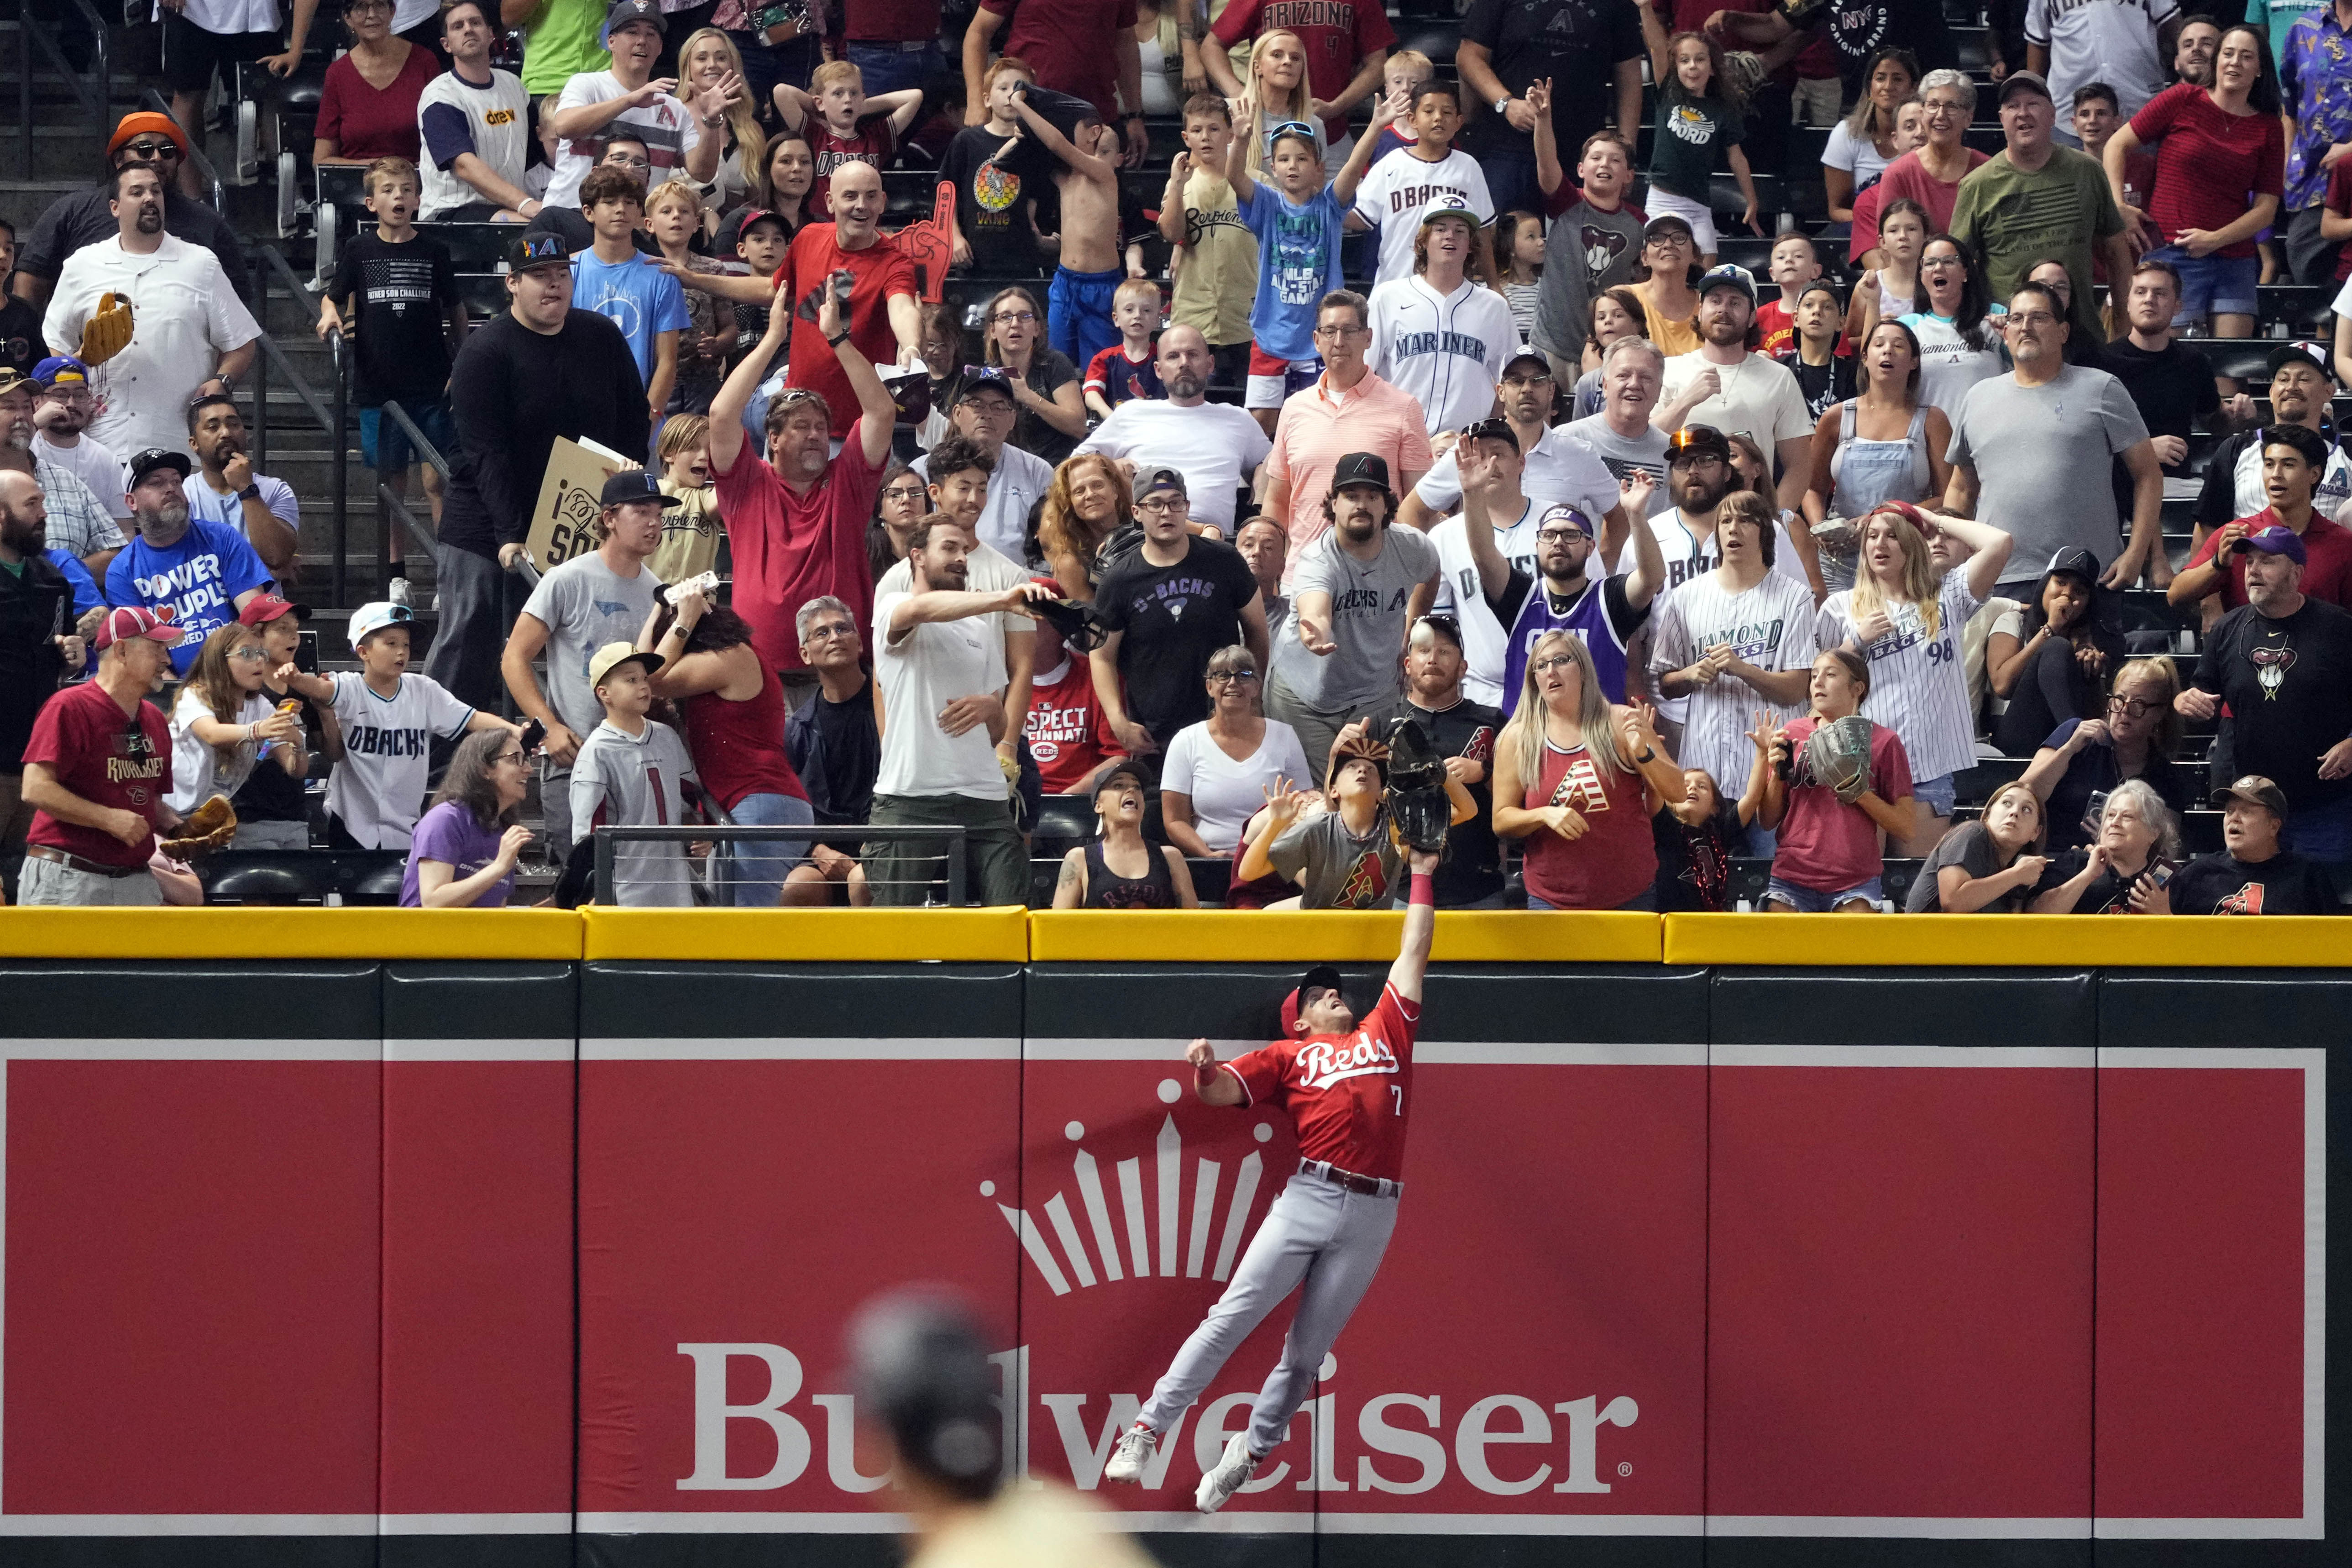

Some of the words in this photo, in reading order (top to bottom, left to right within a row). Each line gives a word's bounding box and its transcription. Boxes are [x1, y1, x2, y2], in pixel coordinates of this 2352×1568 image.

[1263, 2, 1354, 34] ARIZONA
[1867, 8, 1887, 47] BRAND
[1667, 115, 1711, 144] WORD
[1283, 267, 1314, 281] MLB
[367, 289, 385, 299] FATHER
[386, 289, 399, 298] SON
[400, 289, 431, 299] CHALLENGE
[1544, 508, 1573, 523] GCU
[1873, 629, 1926, 659] BACK
[1927, 637, 1953, 666] 98
[1026, 707, 1087, 730] SPECT
[1297, 1033, 1399, 1090] Reds
[1390, 1086, 1403, 1116] 7
